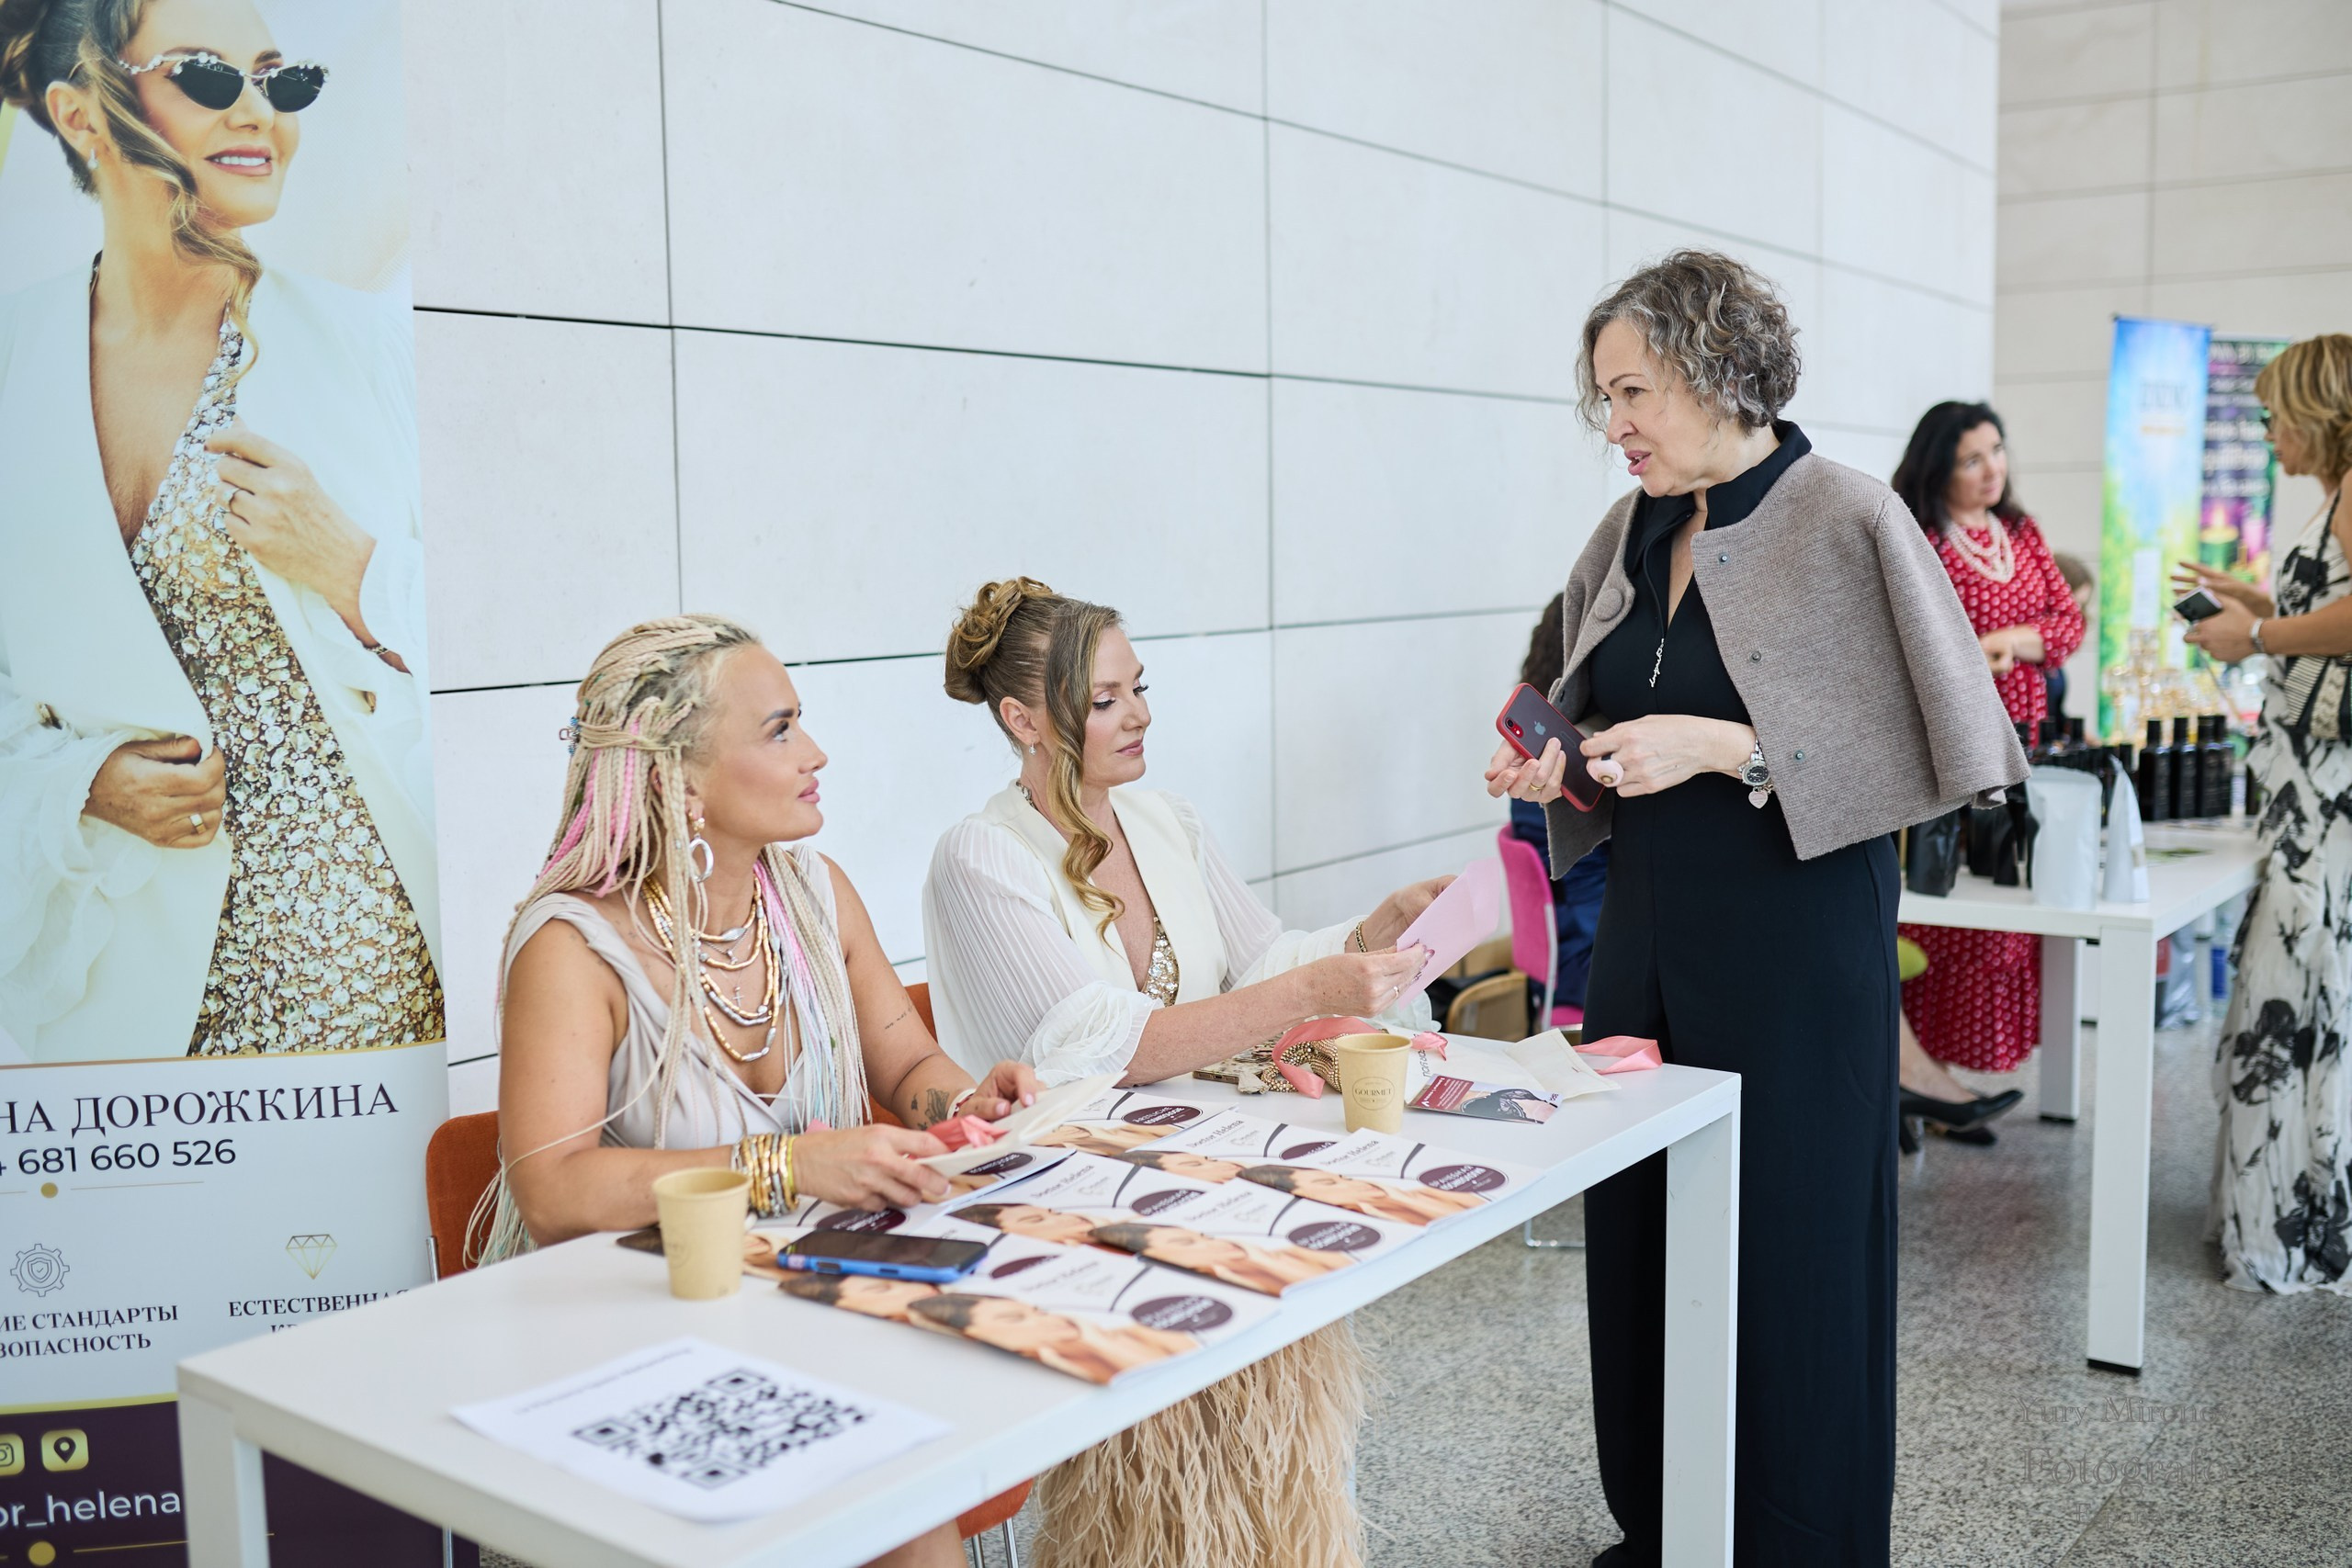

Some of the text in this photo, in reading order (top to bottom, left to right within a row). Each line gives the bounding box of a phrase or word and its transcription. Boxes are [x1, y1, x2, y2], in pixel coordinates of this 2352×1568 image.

[1354, 1088, 1391, 1096] GOURMET
[71, 1082, 400, 1139] ДОРОЖКИНА
[18, 1146, 77, 1175] 681
[91, 1143, 160, 1170] 660
[172, 1139, 237, 1167] 526
[32, 1304, 178, 1330] СТАНДАРТЫ
[228, 1289, 409, 1317] ЕСТЕСТВЕНН
